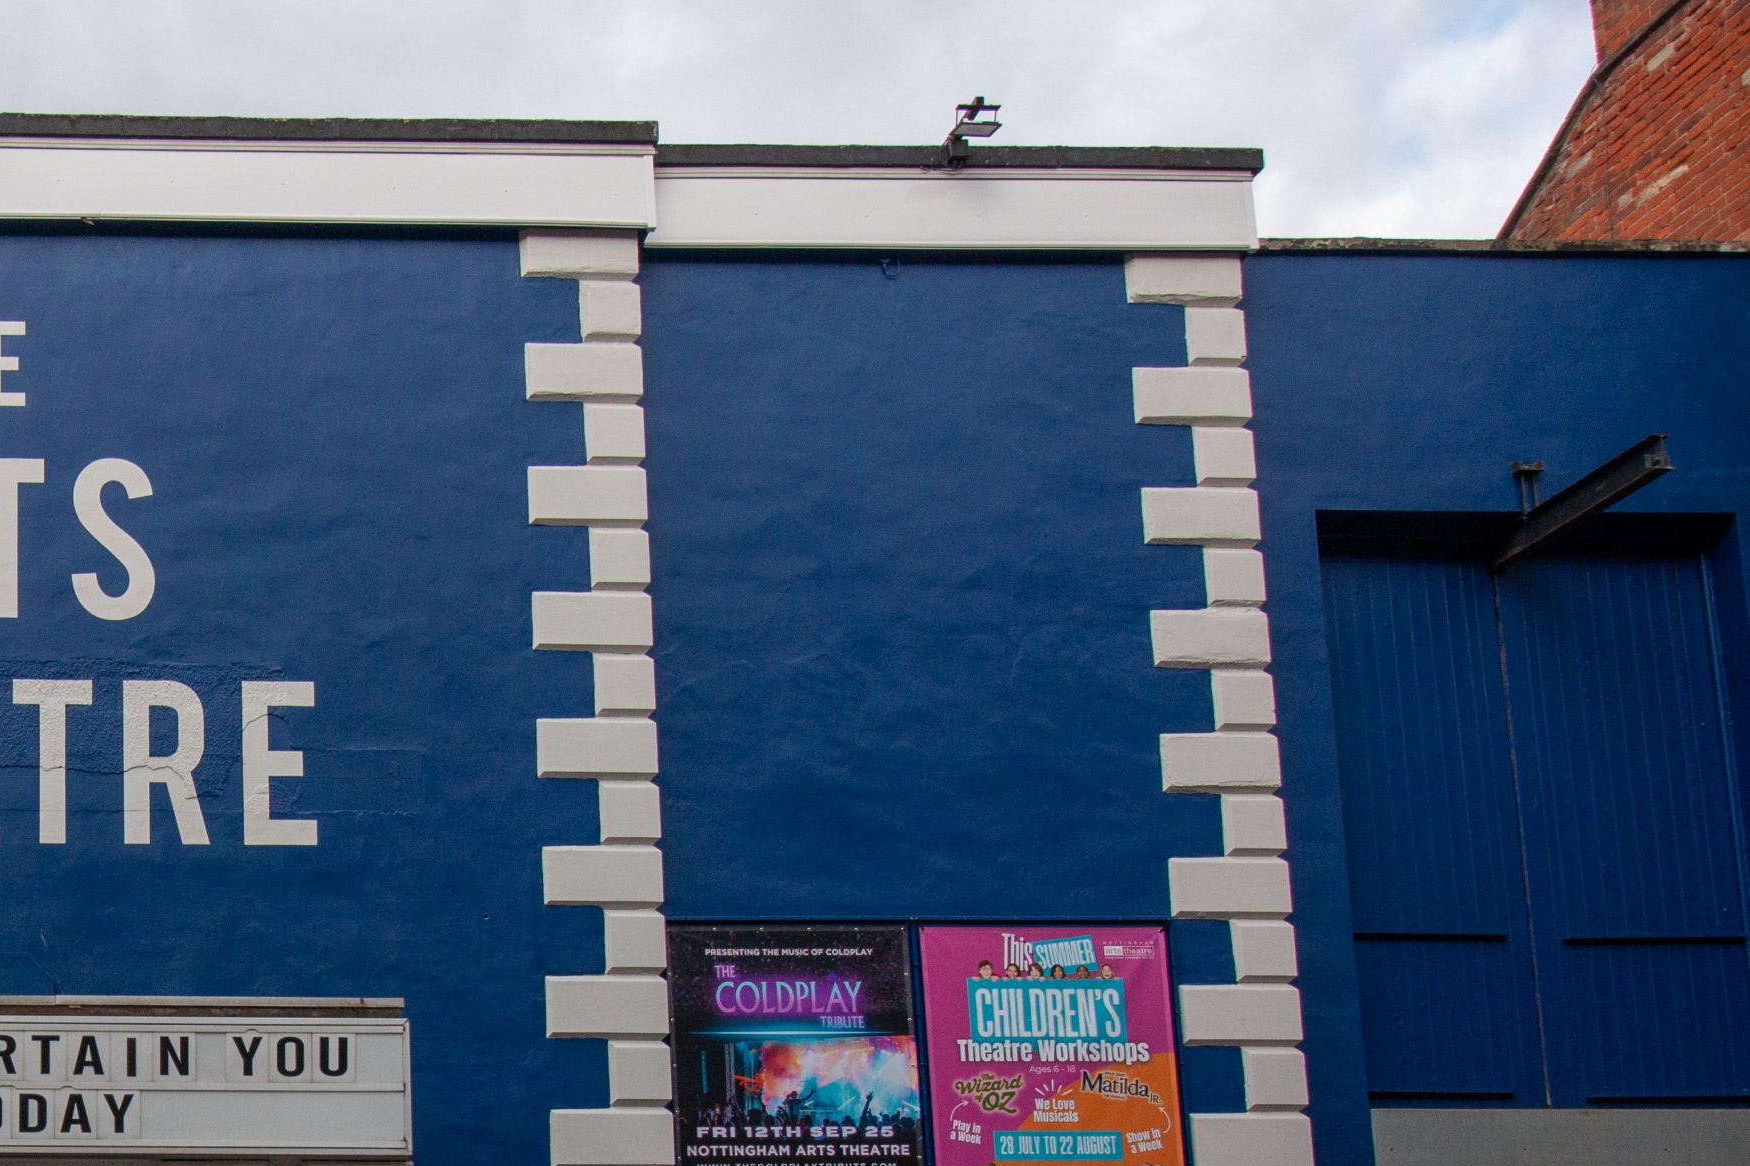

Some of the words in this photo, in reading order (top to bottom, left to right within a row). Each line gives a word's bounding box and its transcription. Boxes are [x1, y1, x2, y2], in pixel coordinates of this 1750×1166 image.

[705, 948, 760, 956] PRESENTING
[762, 948, 779, 956] THE
[781, 948, 809, 956] MUSIC
[811, 948, 824, 956] OF
[825, 948, 873, 957] COLDPLAY
[1002, 933, 1034, 972] This
[1035, 938, 1096, 970] SUMMER
[1123, 947, 1152, 955] theatre
[714, 965, 736, 978] THE
[715, 980, 862, 1013] COLDPLAY
[975, 988, 1122, 1038] CHILDREN'S
[820, 1015, 865, 1028] TRIBUTE
[233, 1035, 351, 1078] YOU
[957, 1040, 1033, 1062] Theatre
[1037, 1040, 1150, 1065] Workshops
[1029, 1065, 1051, 1075] Ages
[1053, 1065, 1060, 1073] 6
[1066, 1065, 1076, 1073] 18
[955, 1074, 1023, 1095] Wizard
[1081, 1070, 1149, 1098] Matilda
[981, 1091, 1017, 1113] OZ
[1034, 1098, 1051, 1110] We
[1052, 1098, 1075, 1110] Love
[1034, 1110, 1079, 1123] Musicals
[696, 1126, 736, 1137] FRI
[744, 1126, 802, 1138] 12TH
[810, 1126, 857, 1138] SEP
[864, 1126, 894, 1137] 25
[952, 1119, 971, 1134] Play
[972, 1122, 981, 1134] in
[950, 1131, 957, 1140] a
[958, 1132, 981, 1145] Week
[1126, 1130, 1150, 1144] Show
[1151, 1127, 1161, 1139] in
[687, 1145, 790, 1157] NOTTINGHAM
[795, 1144, 836, 1157] ARTS
[840, 1144, 910, 1156] THEATRE
[1000, 1135, 1015, 1155] 28
[1017, 1135, 1040, 1155] JULY
[1042, 1135, 1058, 1155] TO
[1059, 1135, 1074, 1155] 22
[1076, 1135, 1117, 1155] AUGUST
[1130, 1145, 1138, 1154] a
[1139, 1139, 1163, 1151] Week
